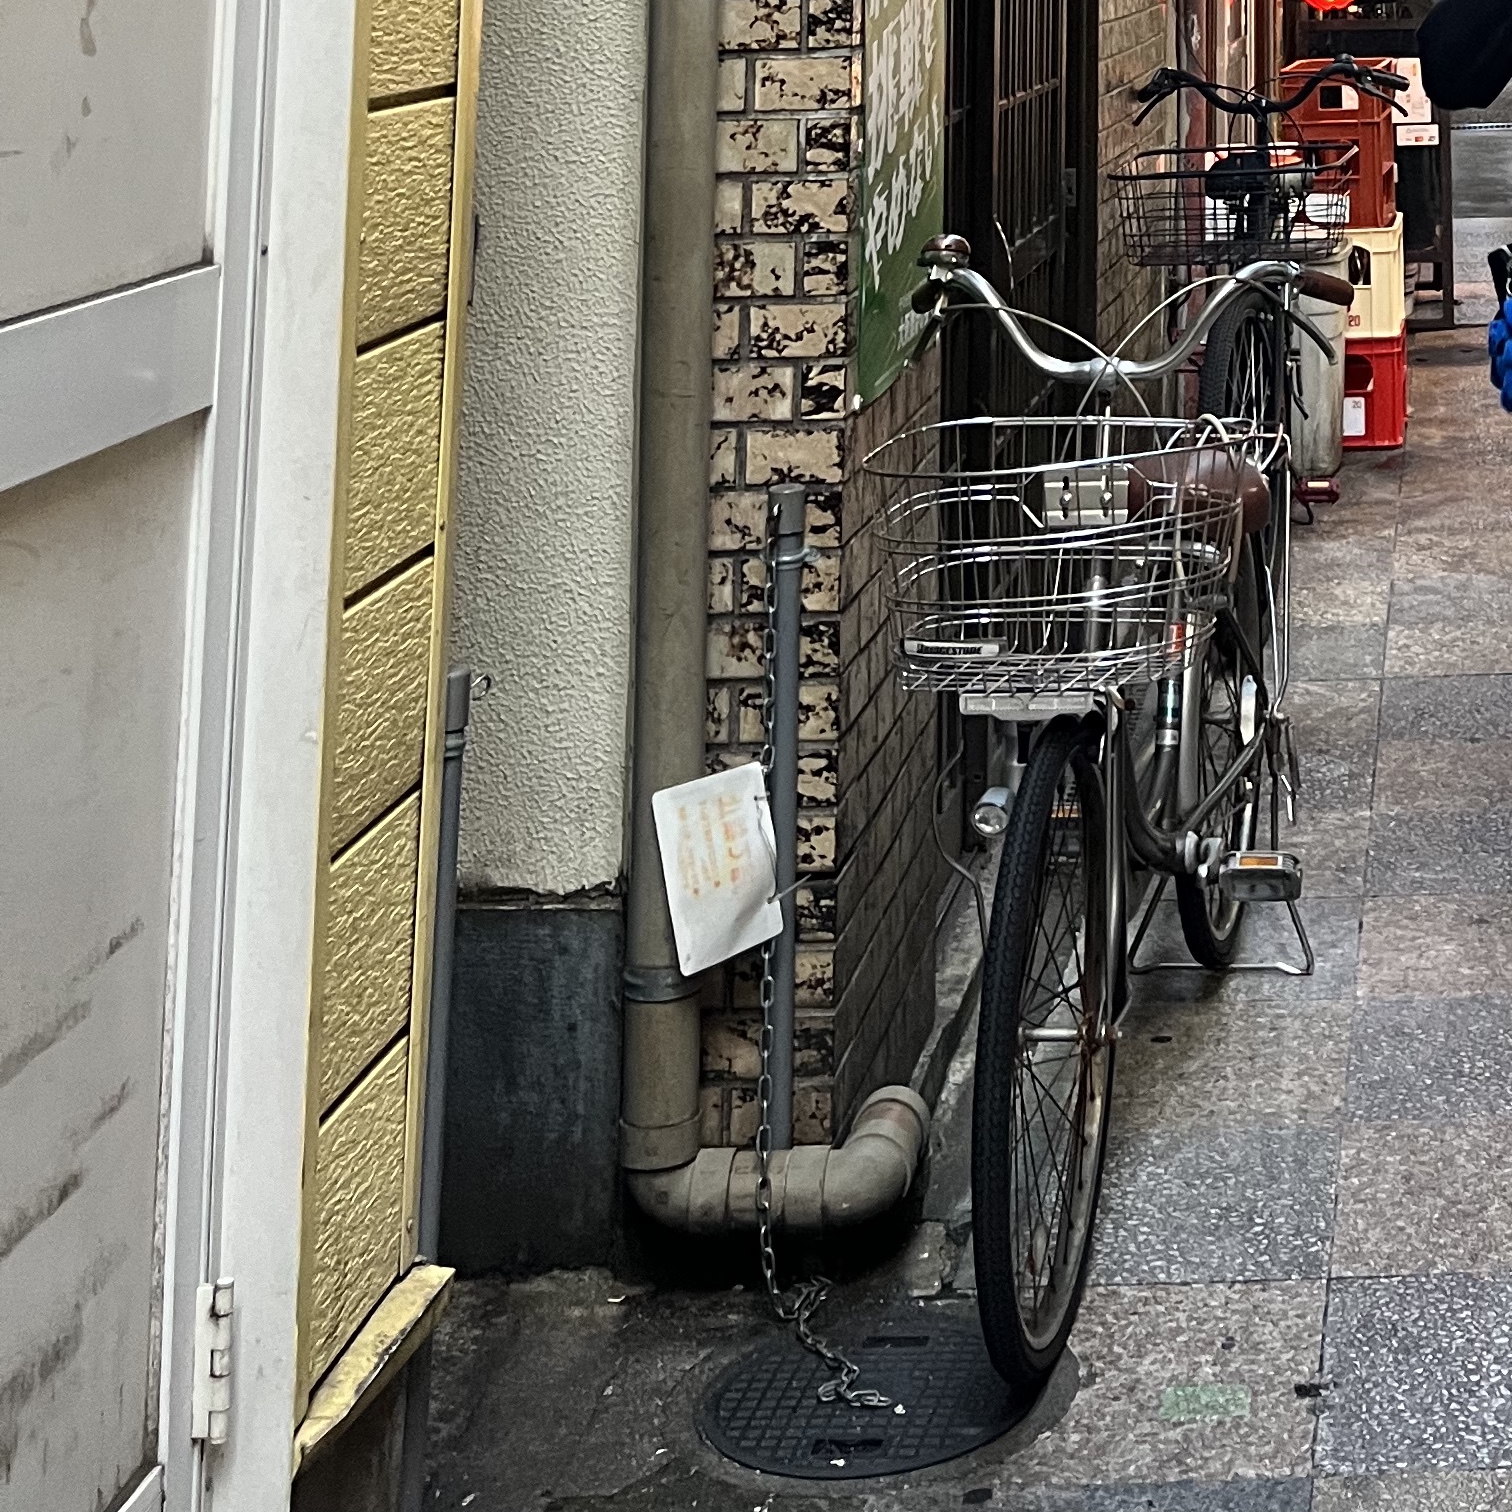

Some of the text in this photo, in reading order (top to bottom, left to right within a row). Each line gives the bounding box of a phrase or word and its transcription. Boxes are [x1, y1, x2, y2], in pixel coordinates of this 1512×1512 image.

[864, 92, 940, 293] やめない
[1347, 314, 1360, 326] 20
